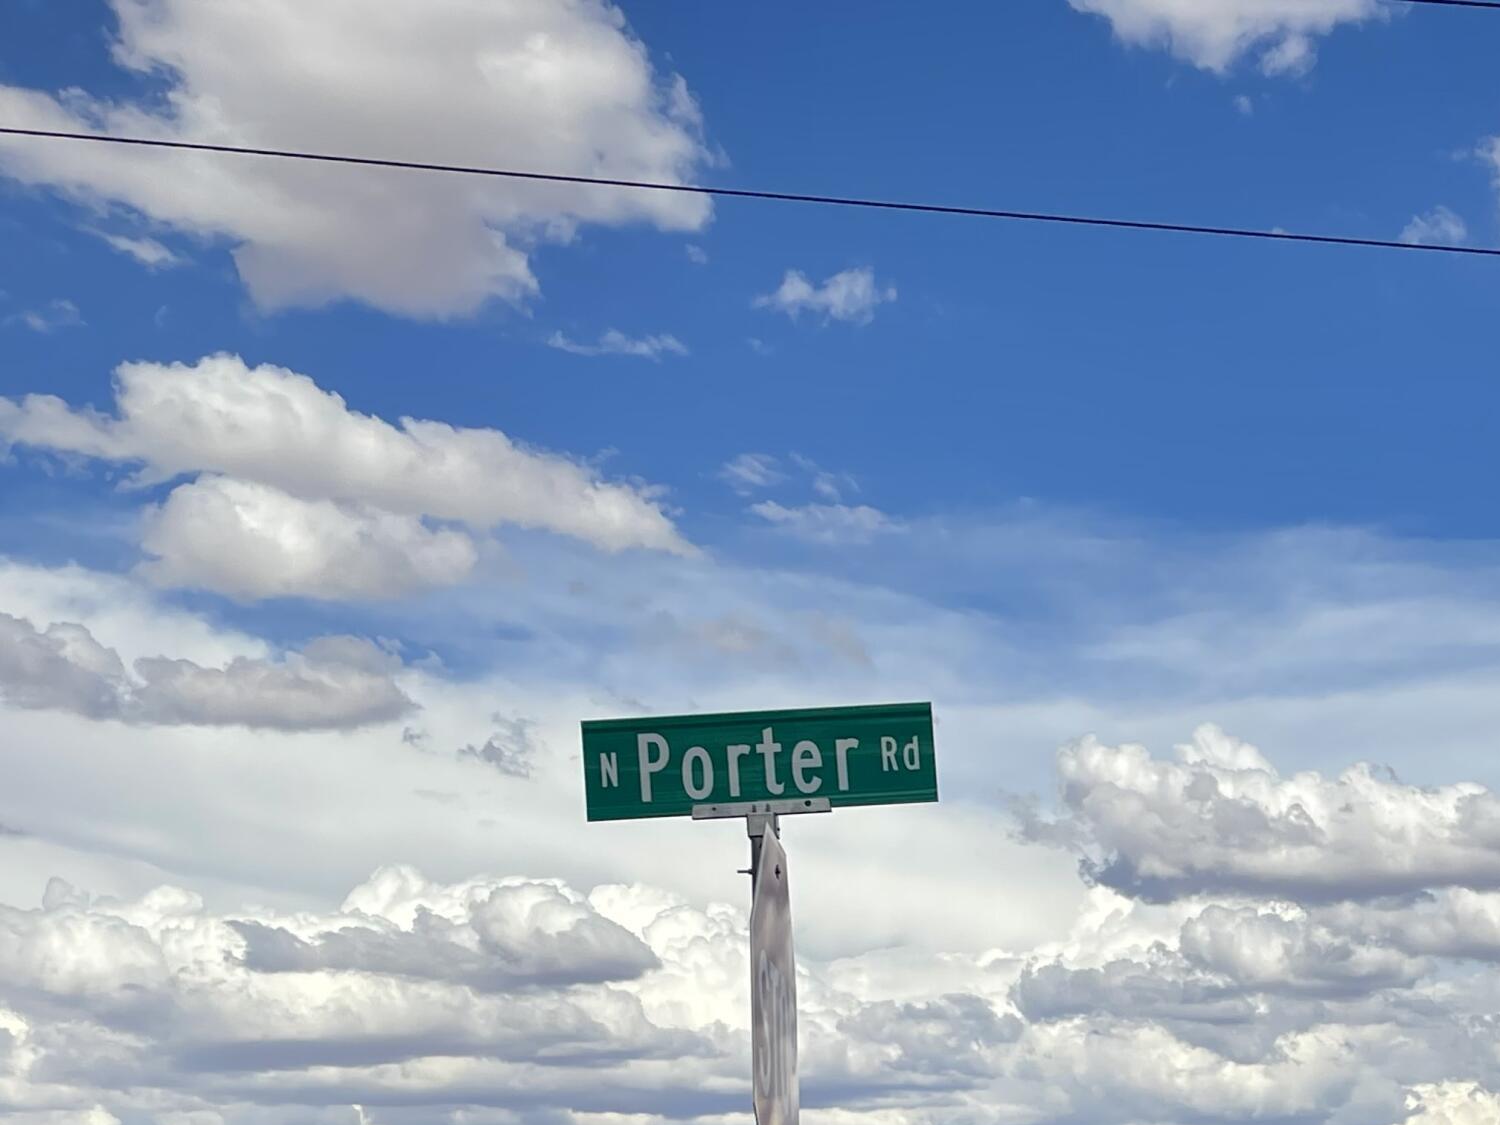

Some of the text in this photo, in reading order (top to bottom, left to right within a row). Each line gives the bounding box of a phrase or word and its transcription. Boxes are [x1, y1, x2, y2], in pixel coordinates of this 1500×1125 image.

[600, 727, 921, 802] N Porter Rd
